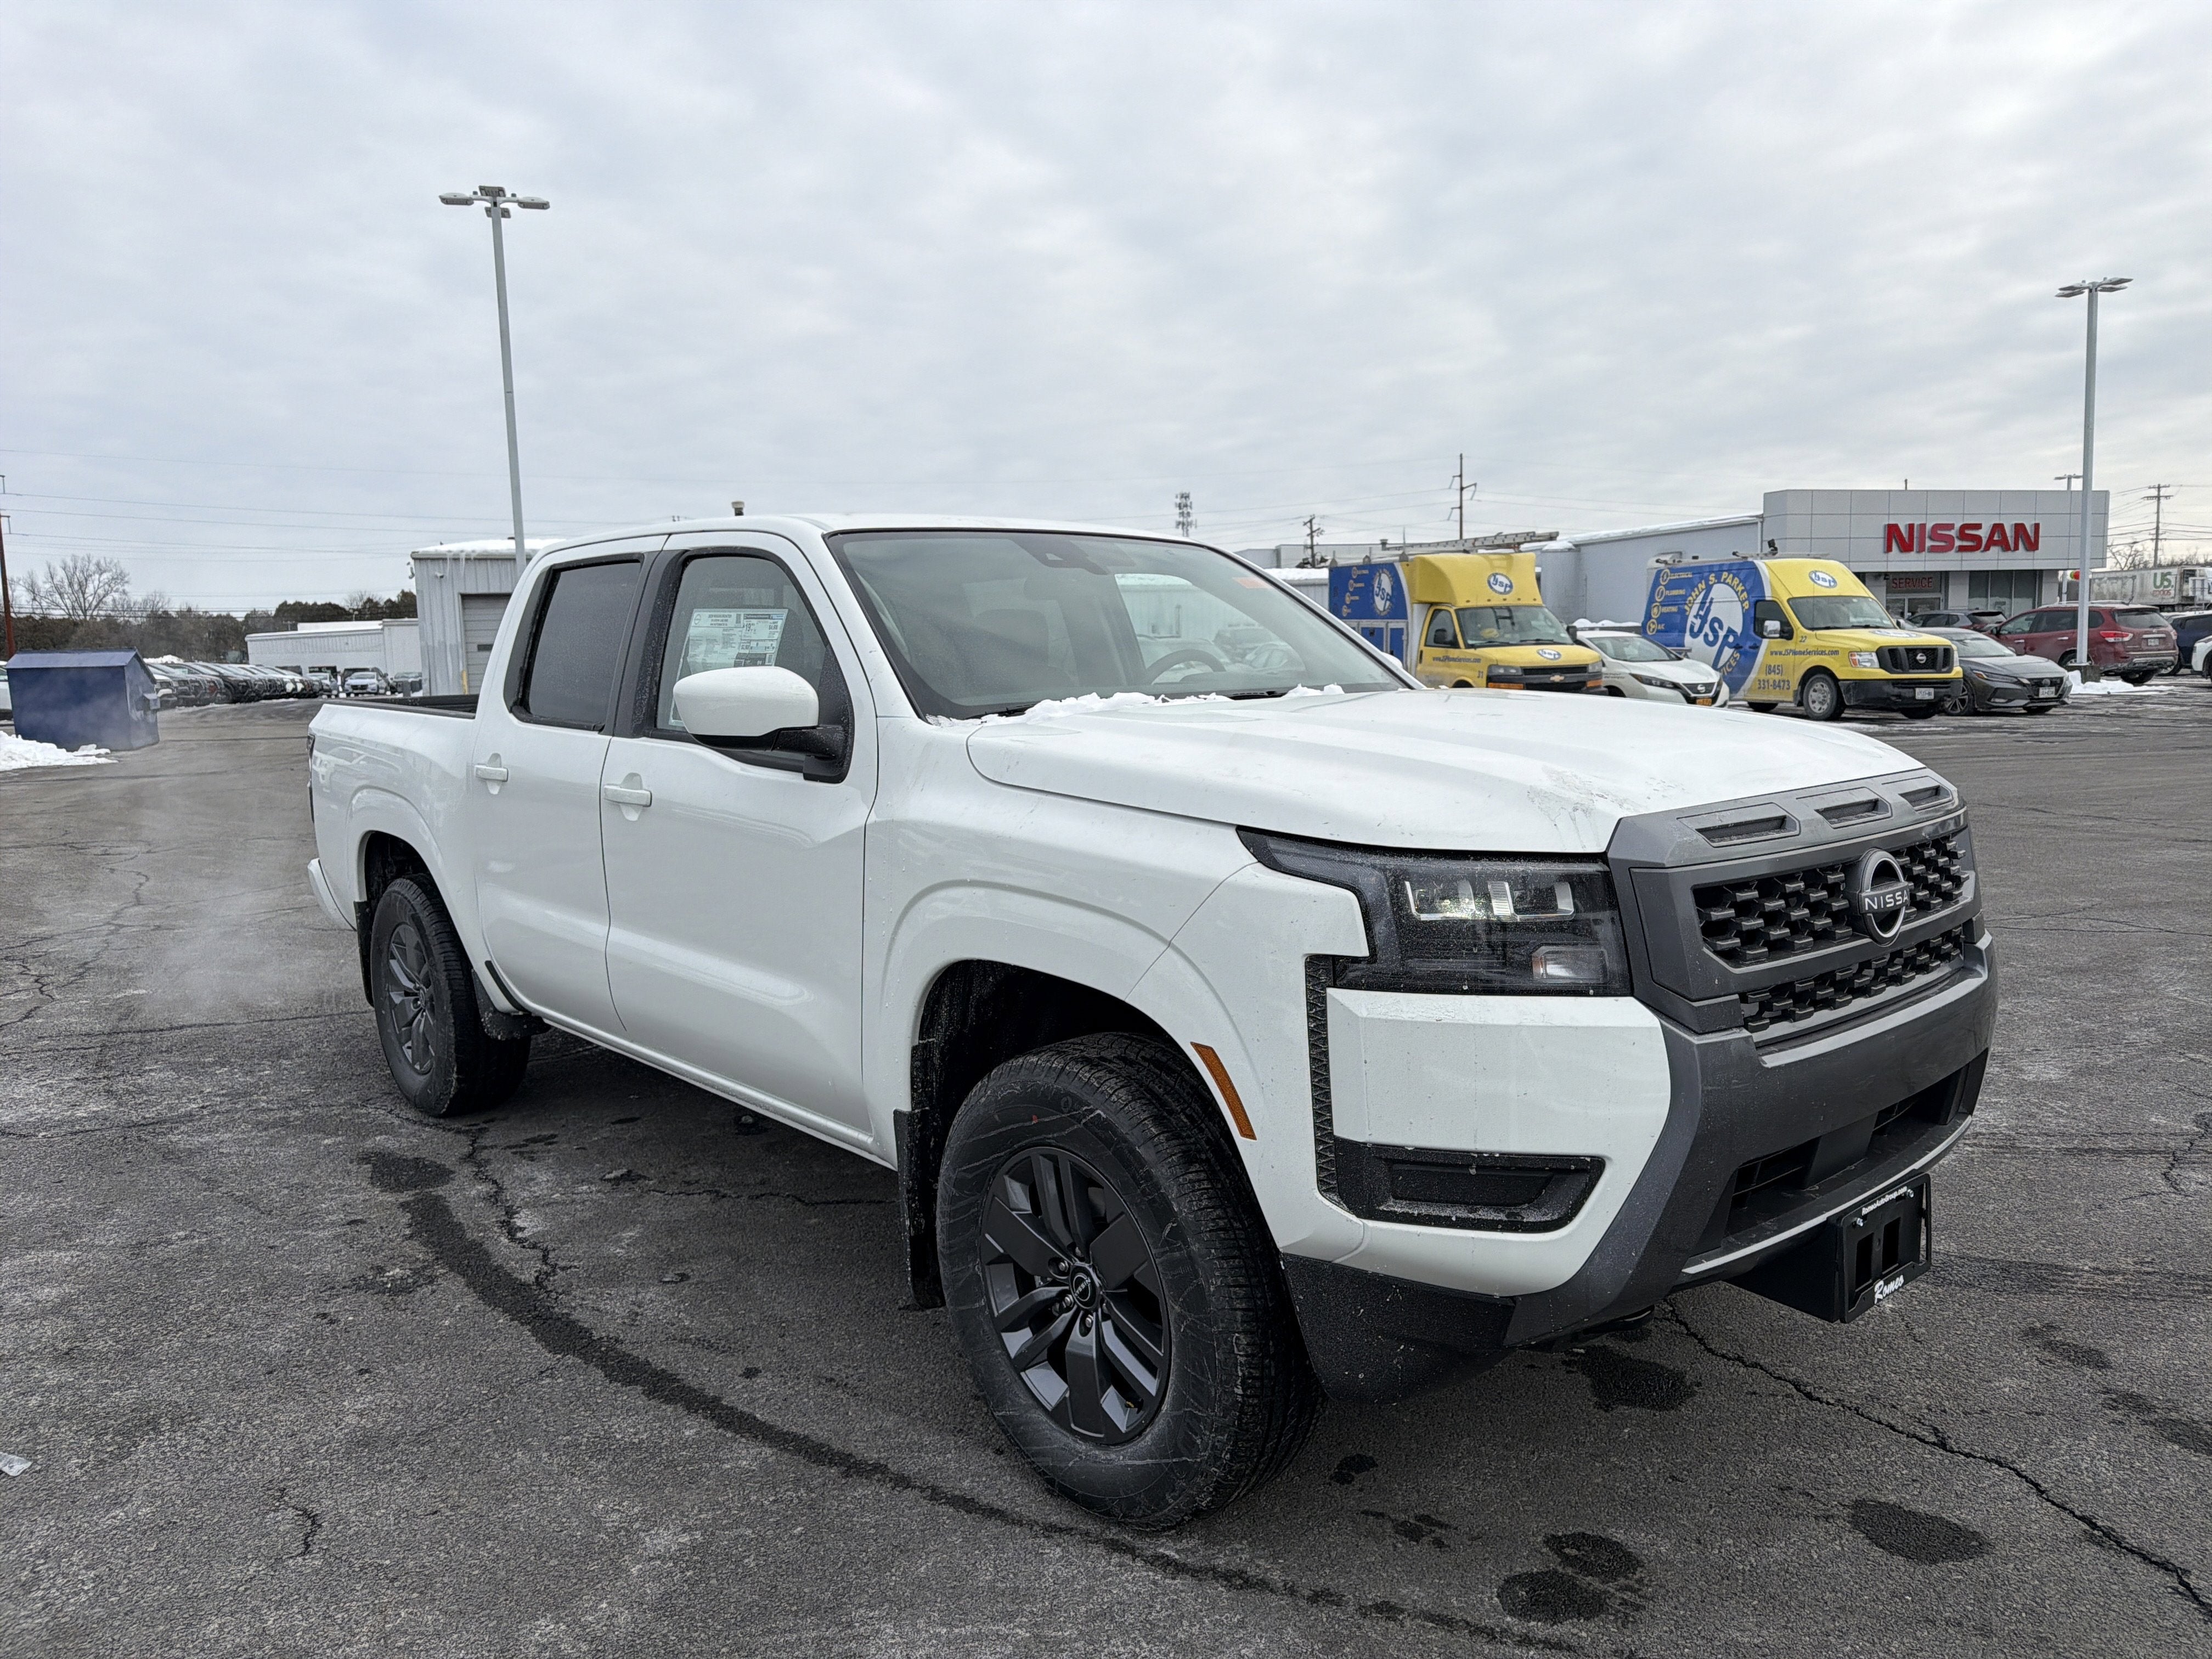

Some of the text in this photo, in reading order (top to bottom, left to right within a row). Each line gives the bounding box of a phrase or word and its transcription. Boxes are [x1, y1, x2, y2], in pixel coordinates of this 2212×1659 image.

[1885, 523, 2040, 552] NISSAN
[1684, 572, 1750, 615] JOHN S. PARKER
[1892, 577, 1933, 589] SERVICE
[1689, 588, 1740, 669] JSP
[1770, 648, 1840, 656] www.JSPHomeServices.com
[1765, 664, 1783, 676] (845)
[1757, 679, 1791, 690] 331-8473
[1865, 890, 1909, 911] NISSA
[1875, 1274, 1904, 1304] Romeo
